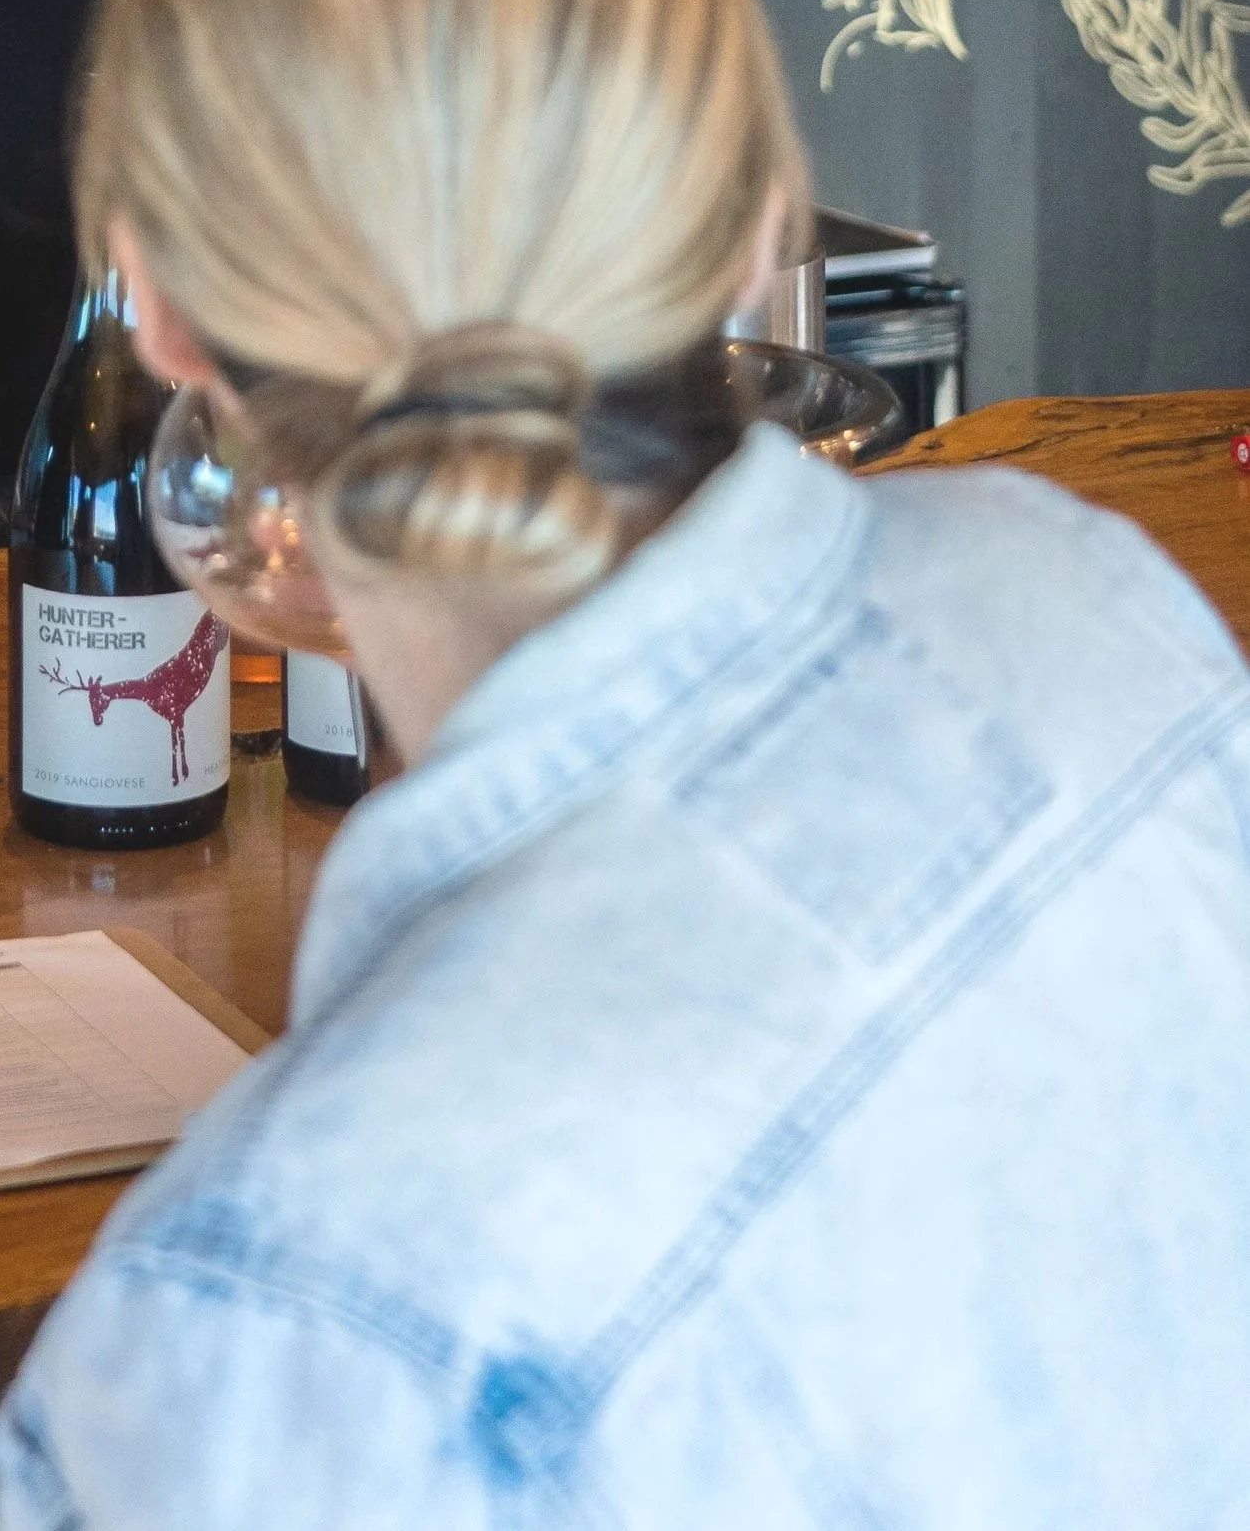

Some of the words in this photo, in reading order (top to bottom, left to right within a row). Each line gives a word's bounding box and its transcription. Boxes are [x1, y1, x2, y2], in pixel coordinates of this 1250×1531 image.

[38, 625, 146, 650] GATHERER
[34, 769, 60, 785] 2019
[64, 775, 146, 789] SANGIOVESE
